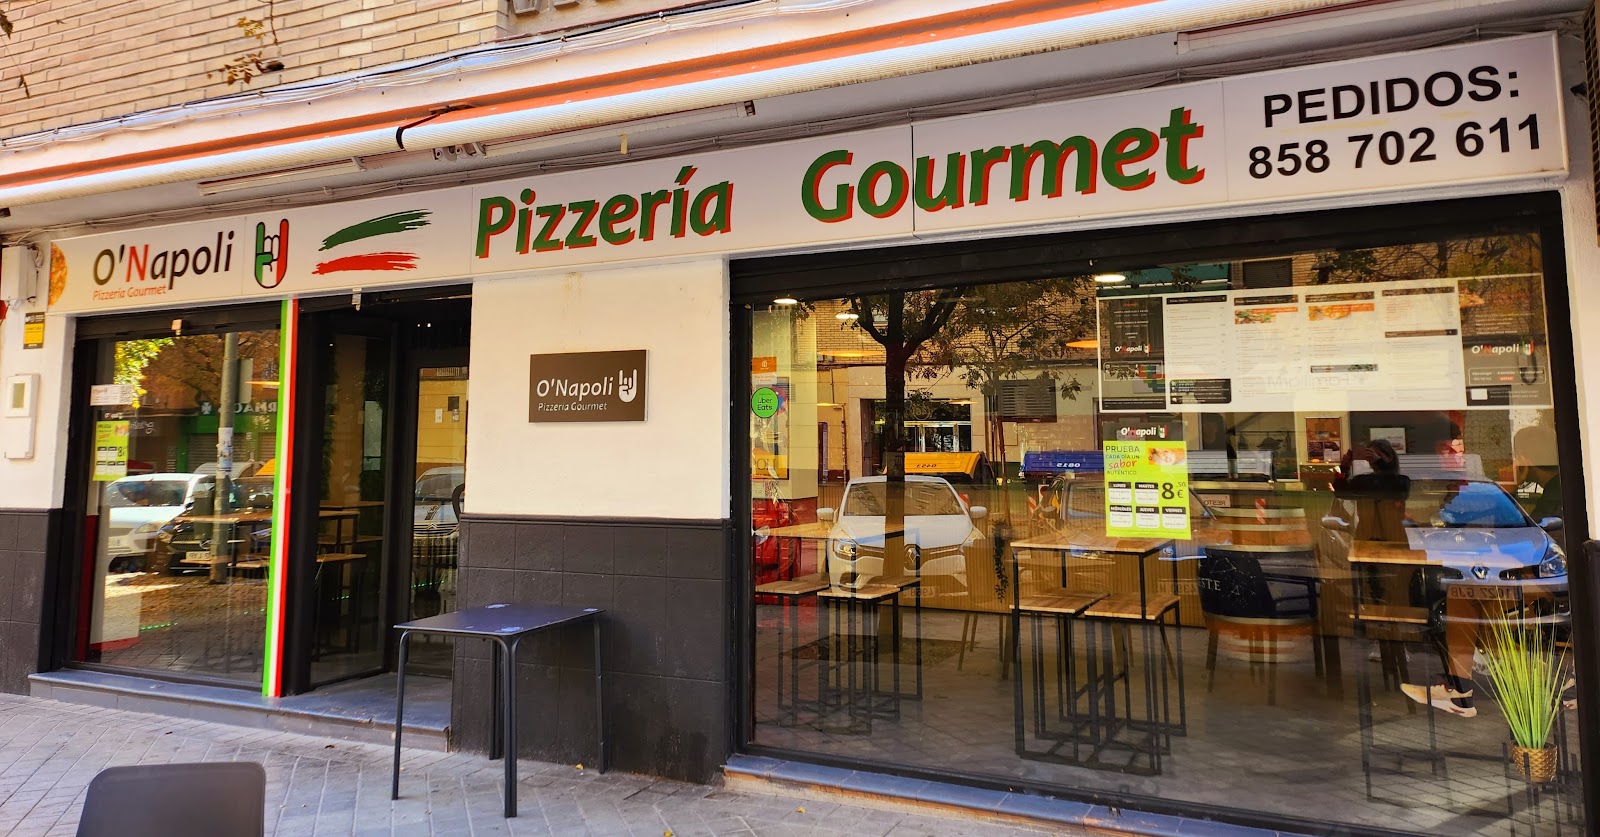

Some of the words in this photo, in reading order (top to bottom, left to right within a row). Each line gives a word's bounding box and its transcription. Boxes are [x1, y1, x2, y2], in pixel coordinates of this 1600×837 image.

[1263, 65, 1520, 128] PEDIDOS:
[1248, 139, 1331, 179] 858
[1347, 127, 1437, 169] 702
[1455, 113, 1540, 158] 611
[475, 165, 734, 259] Pizzería
[801, 106, 1205, 223] Gourmet
[93, 230, 235, 290] O'Napoli
[127, 285, 167, 298] Gourmet
[1471, 343, 1520, 356] O'Napoli
[536, 376, 614, 401] O'Napoli
[570, 401, 608, 411] Gourmet
[1121, 427, 1157, 437] O'Napoli
[1105, 445, 1140, 453] PRUEBA
[1108, 459, 1138, 469] sabor
[1162, 482, 1175, 499] 8
[1177, 489, 1184, 498] €
